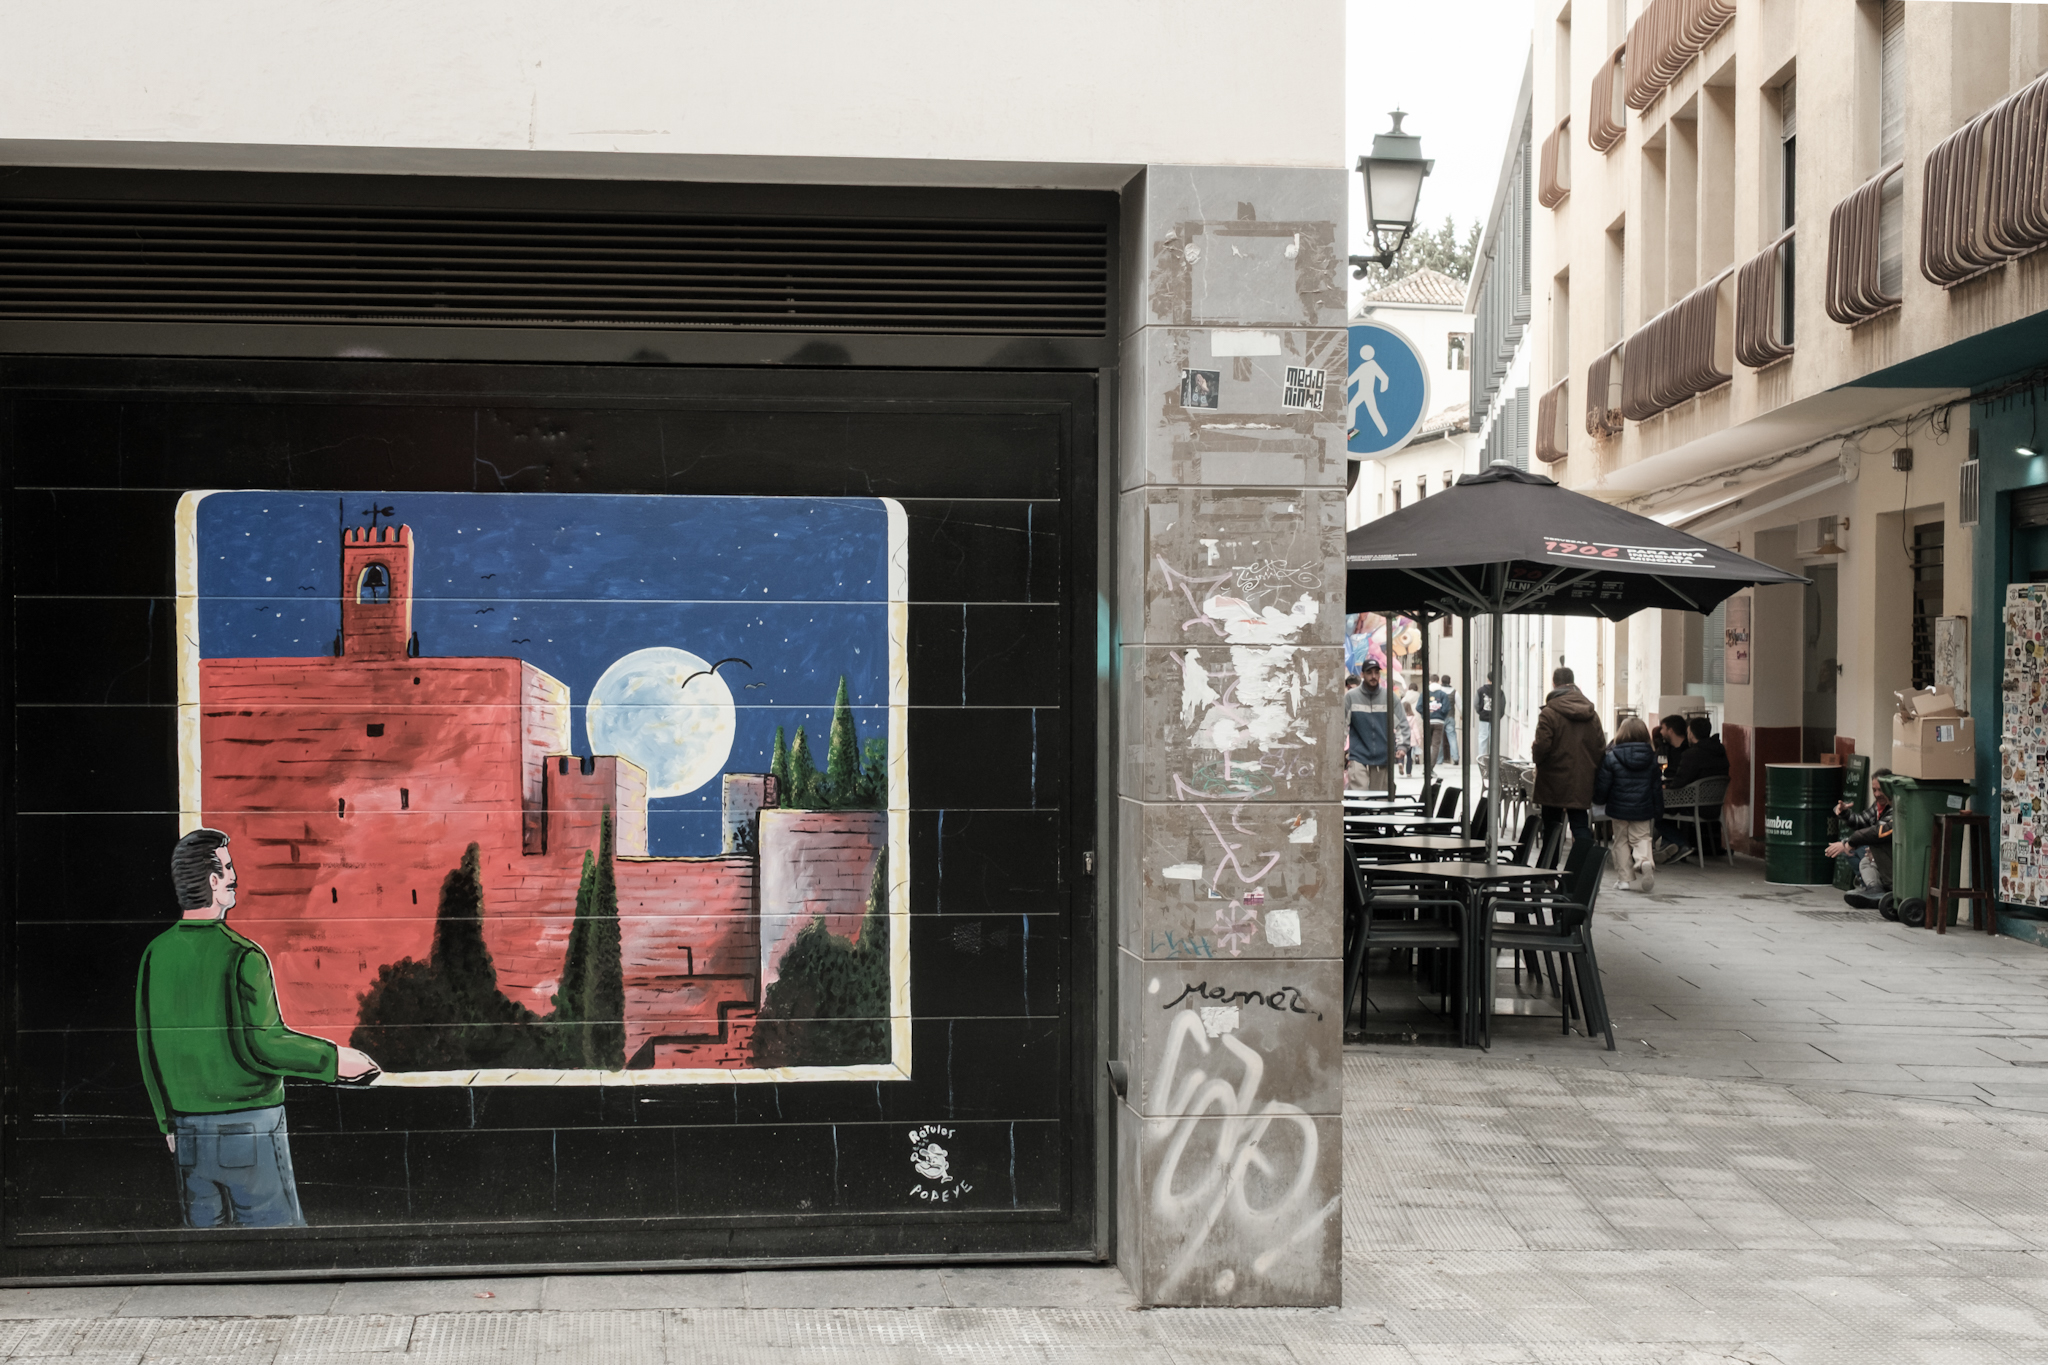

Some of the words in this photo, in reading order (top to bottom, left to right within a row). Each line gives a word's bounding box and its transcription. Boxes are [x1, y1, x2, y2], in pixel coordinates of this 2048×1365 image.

[1545, 541, 1620, 557] 1906
[1626, 548, 1669, 556] PARA
[909, 1180, 973, 1203] POPEYE
